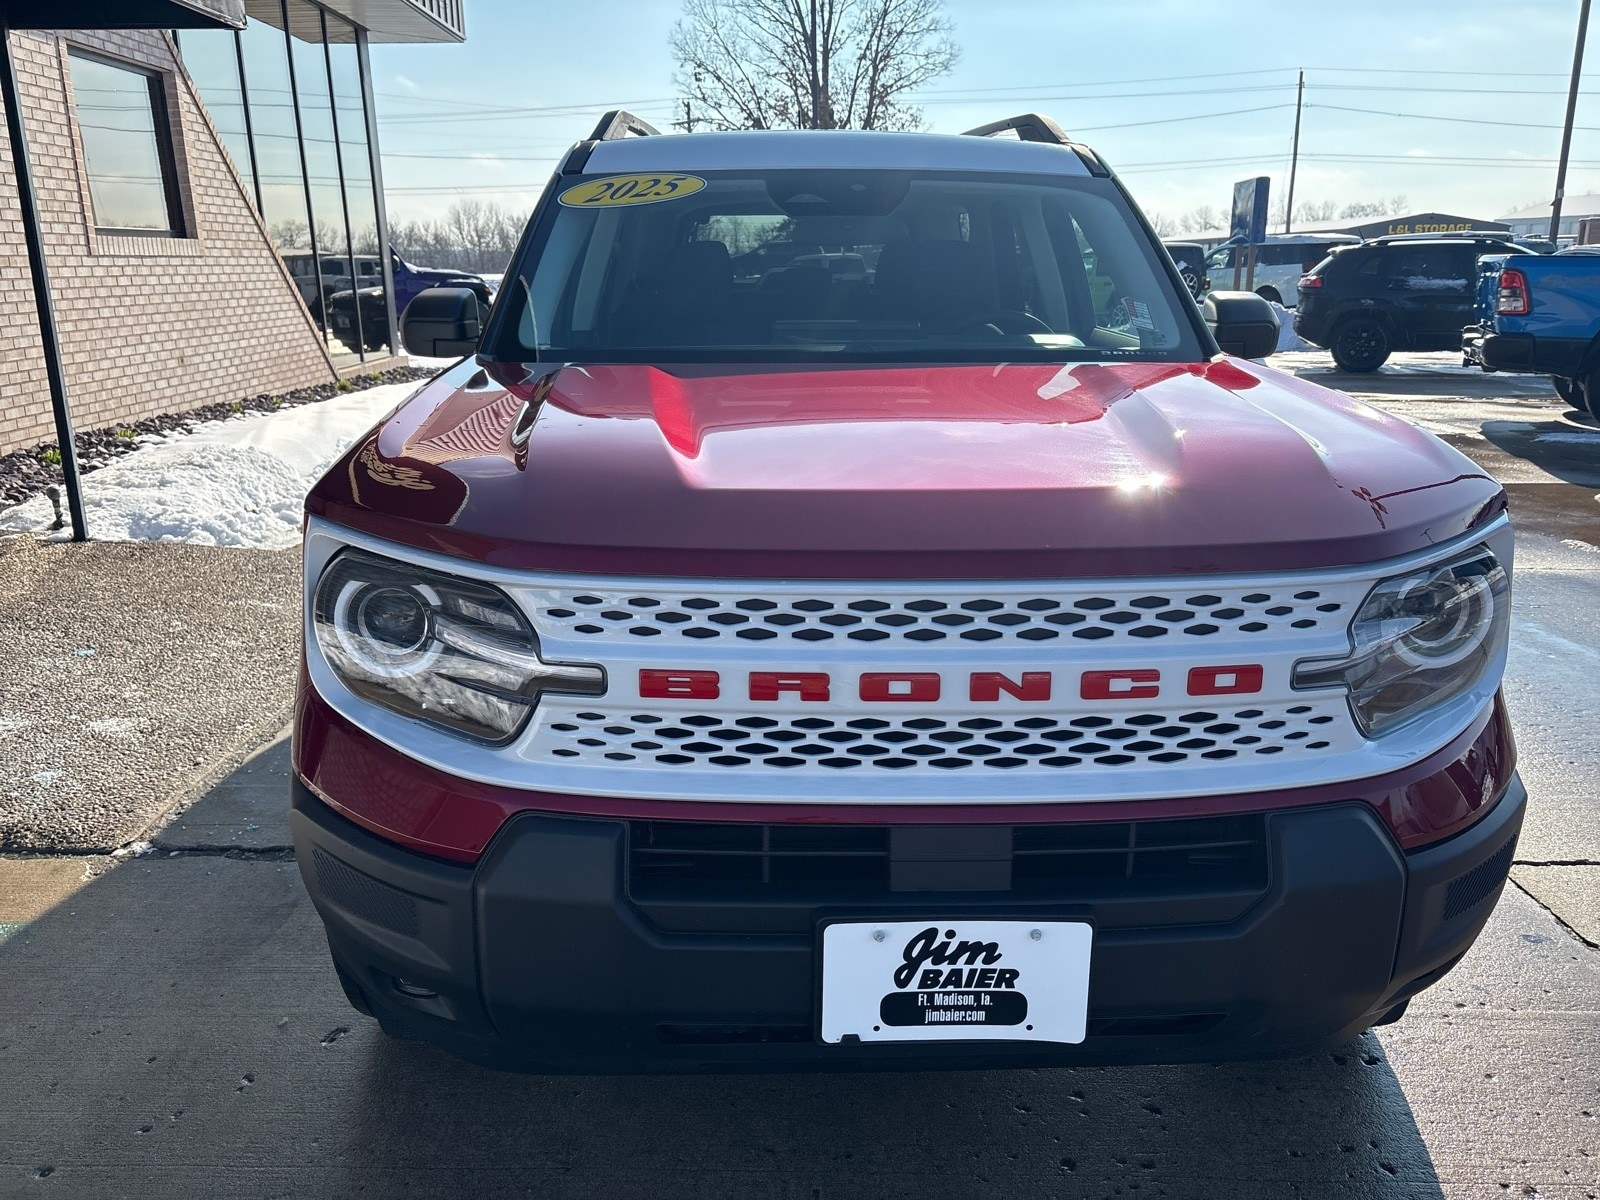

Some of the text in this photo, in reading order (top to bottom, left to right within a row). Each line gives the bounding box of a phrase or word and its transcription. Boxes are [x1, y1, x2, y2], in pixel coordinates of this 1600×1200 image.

[582, 177, 687, 203] 2025
[1388, 223, 1472, 234] L&L STORAGE
[638, 664, 1265, 702] BRONCO
[893, 927, 1002, 989] Jim
[917, 968, 1020, 989] BAIER
[917, 993, 931, 1006] Ft.
[934, 993, 977, 1007] Madison,
[924, 1009, 986, 1023] jimbaier.com
